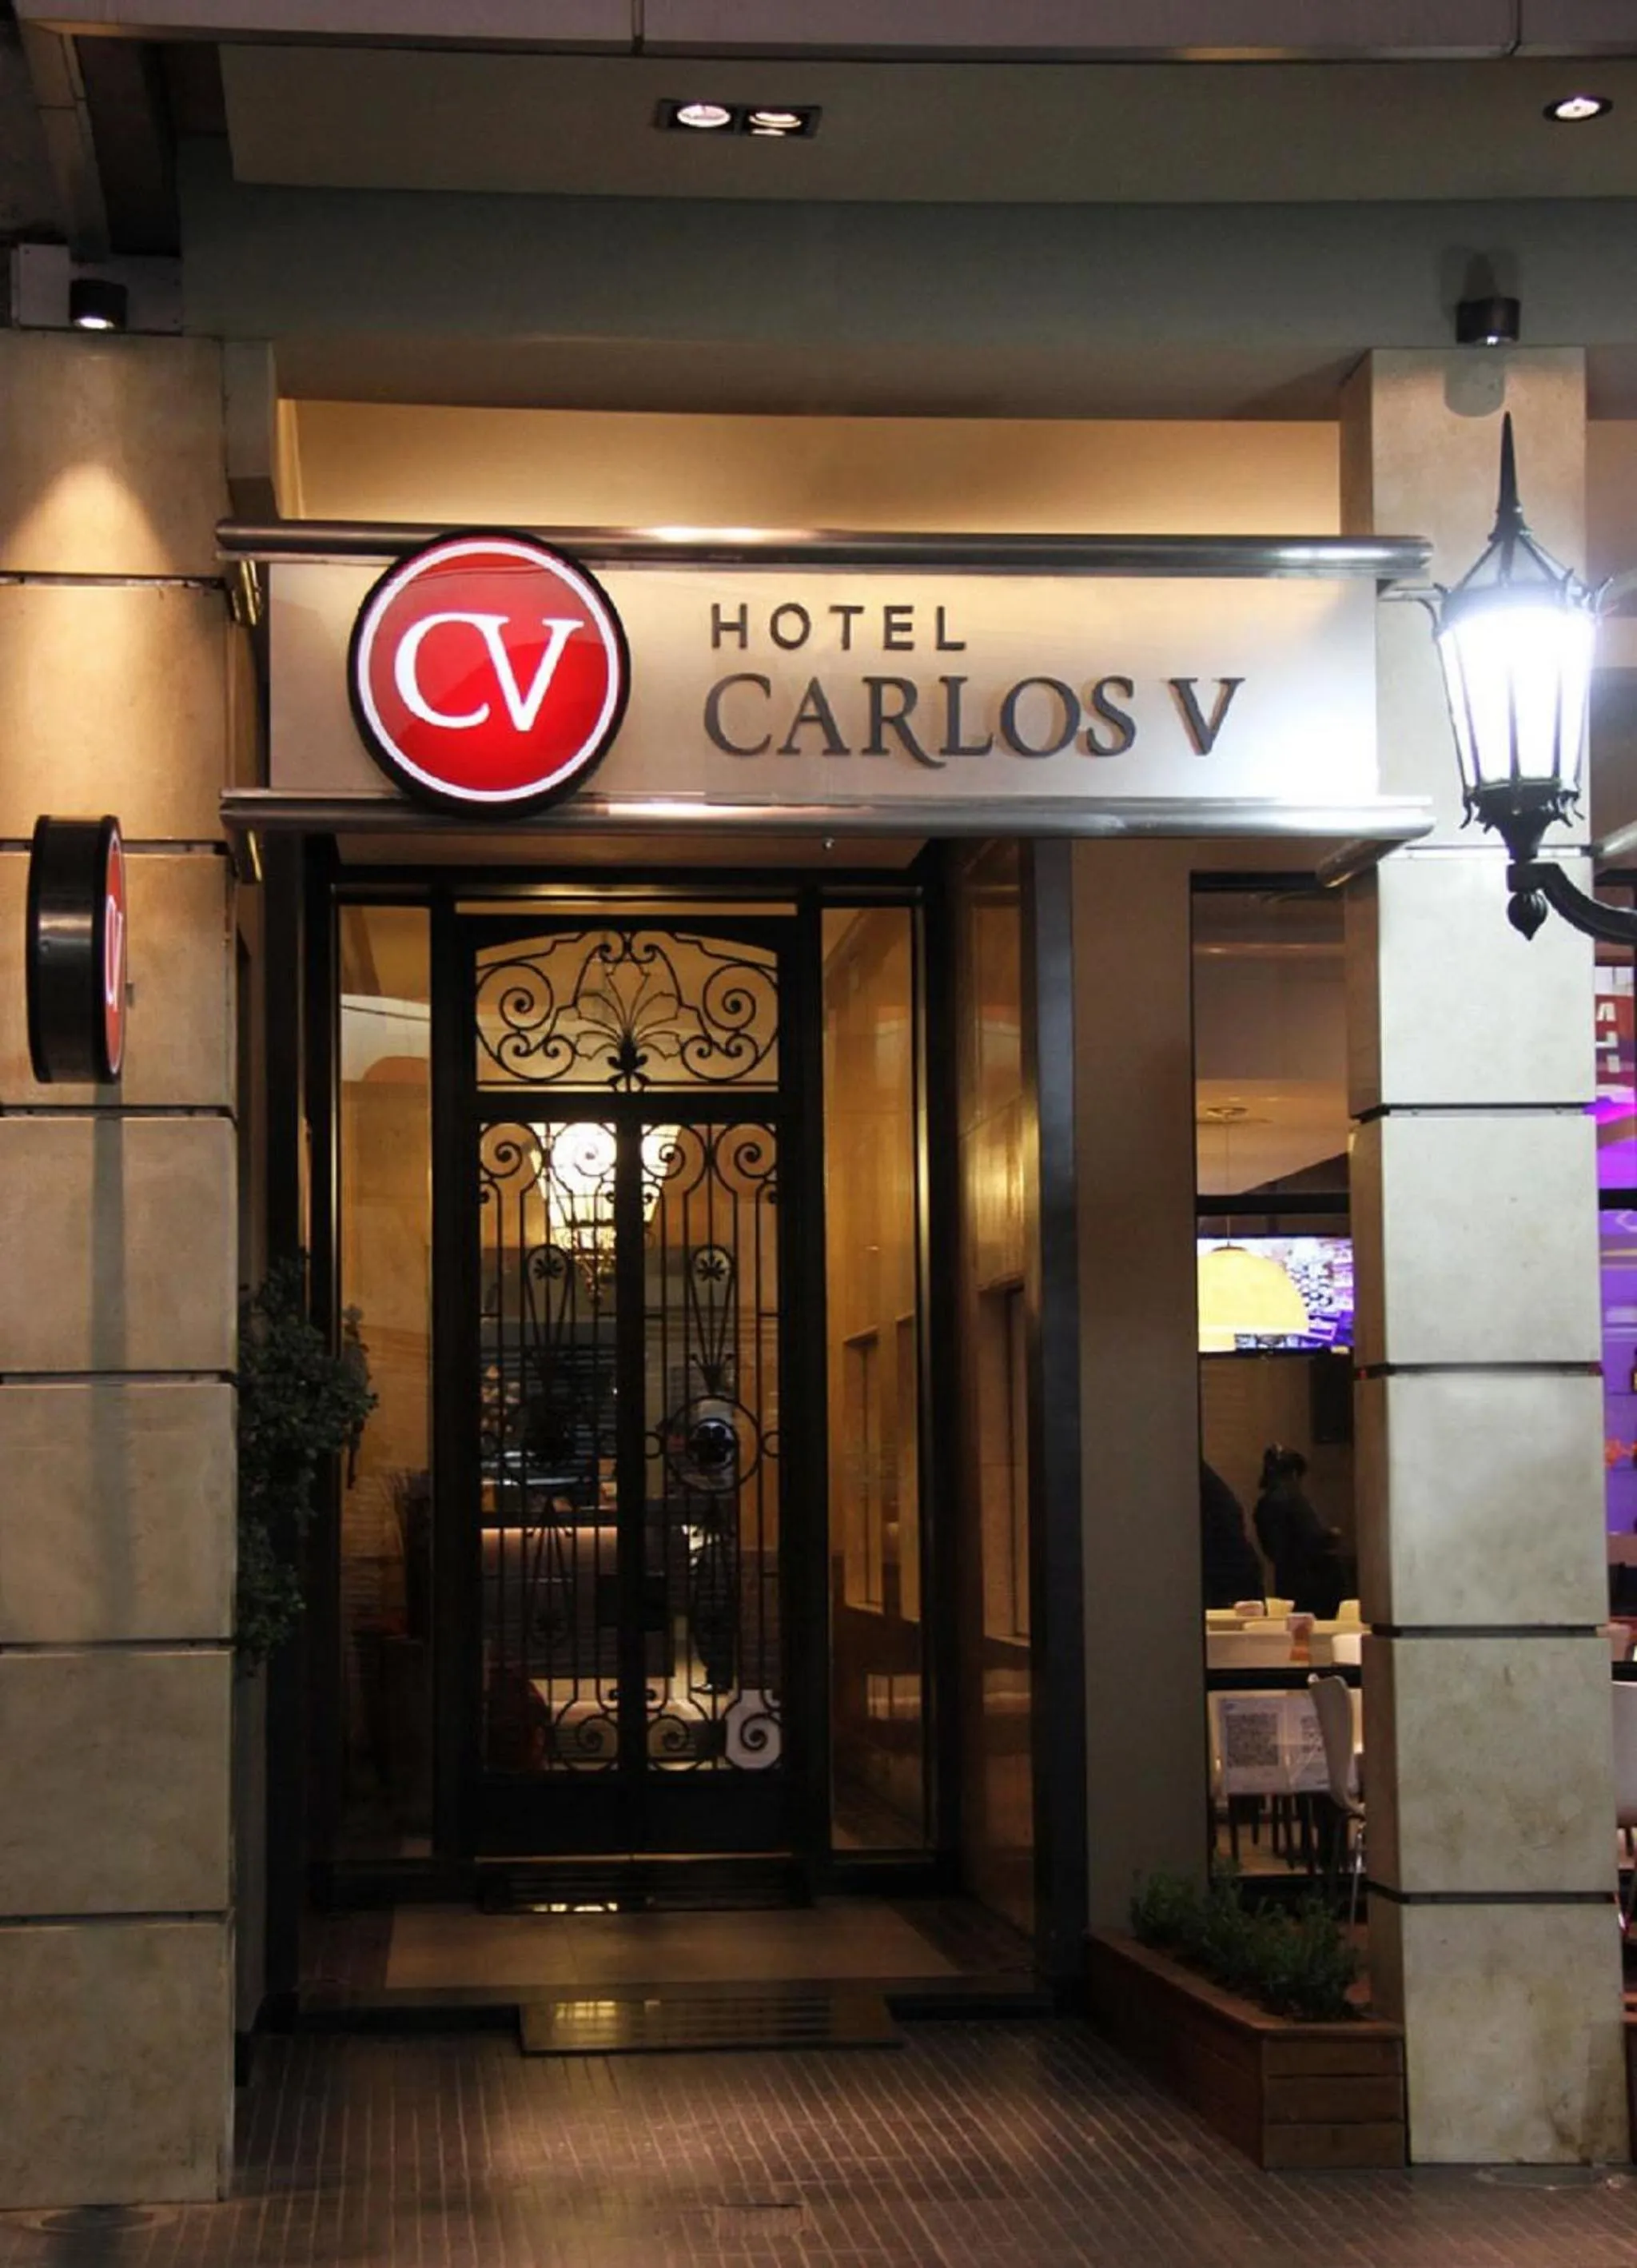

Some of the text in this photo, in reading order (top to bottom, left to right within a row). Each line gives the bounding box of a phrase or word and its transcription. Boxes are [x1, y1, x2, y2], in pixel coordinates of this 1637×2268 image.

[394, 612, 584, 731] CV
[710, 603, 967, 652] HOTEL
[703, 672, 1245, 769] CARLOS V
